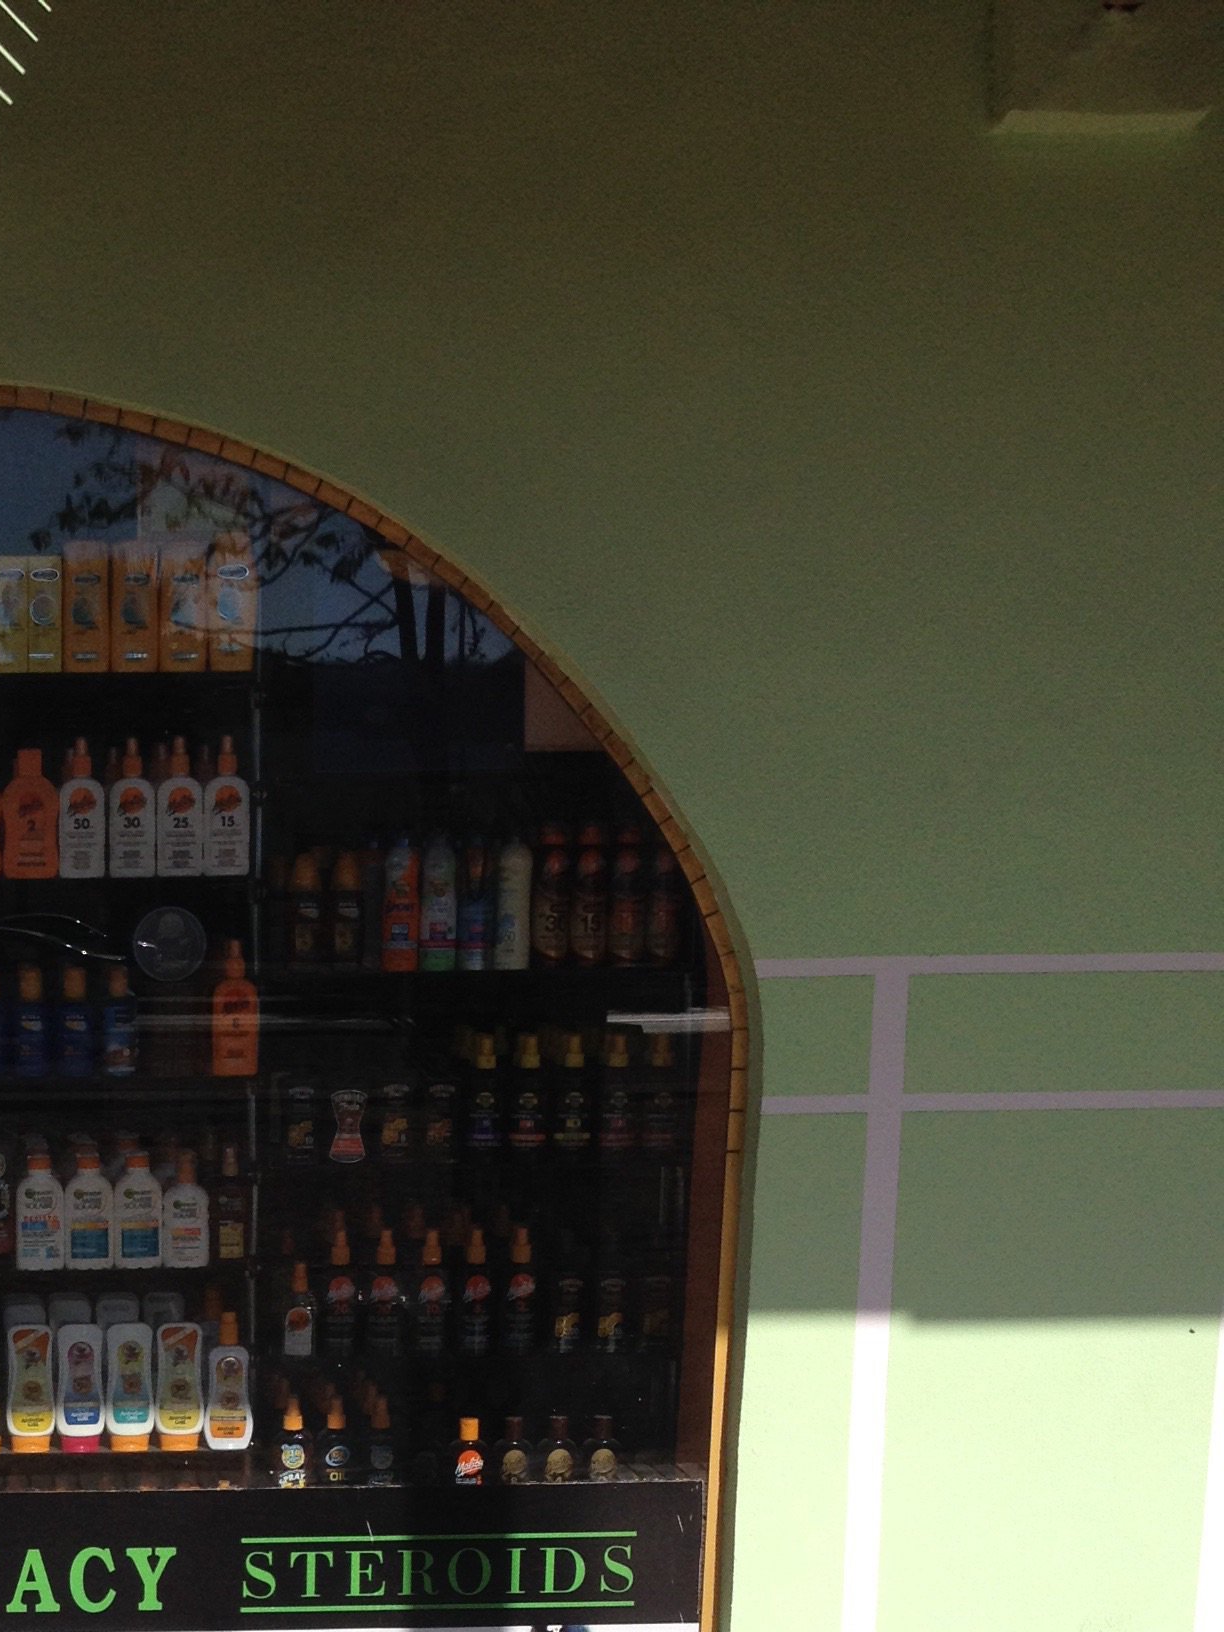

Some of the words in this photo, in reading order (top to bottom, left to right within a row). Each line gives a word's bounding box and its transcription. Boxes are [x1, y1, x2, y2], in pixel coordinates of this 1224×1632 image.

[26, 820, 36, 832] 2
[73, 818, 90, 829] 50
[123, 817, 140, 828] 30
[173, 817, 189, 829] 25
[221, 816, 235, 827] 15
[581, 916, 600, 932] 15
[455, 1457, 484, 1478] Malibu
[242, 1545, 635, 1599] STEROIDS
